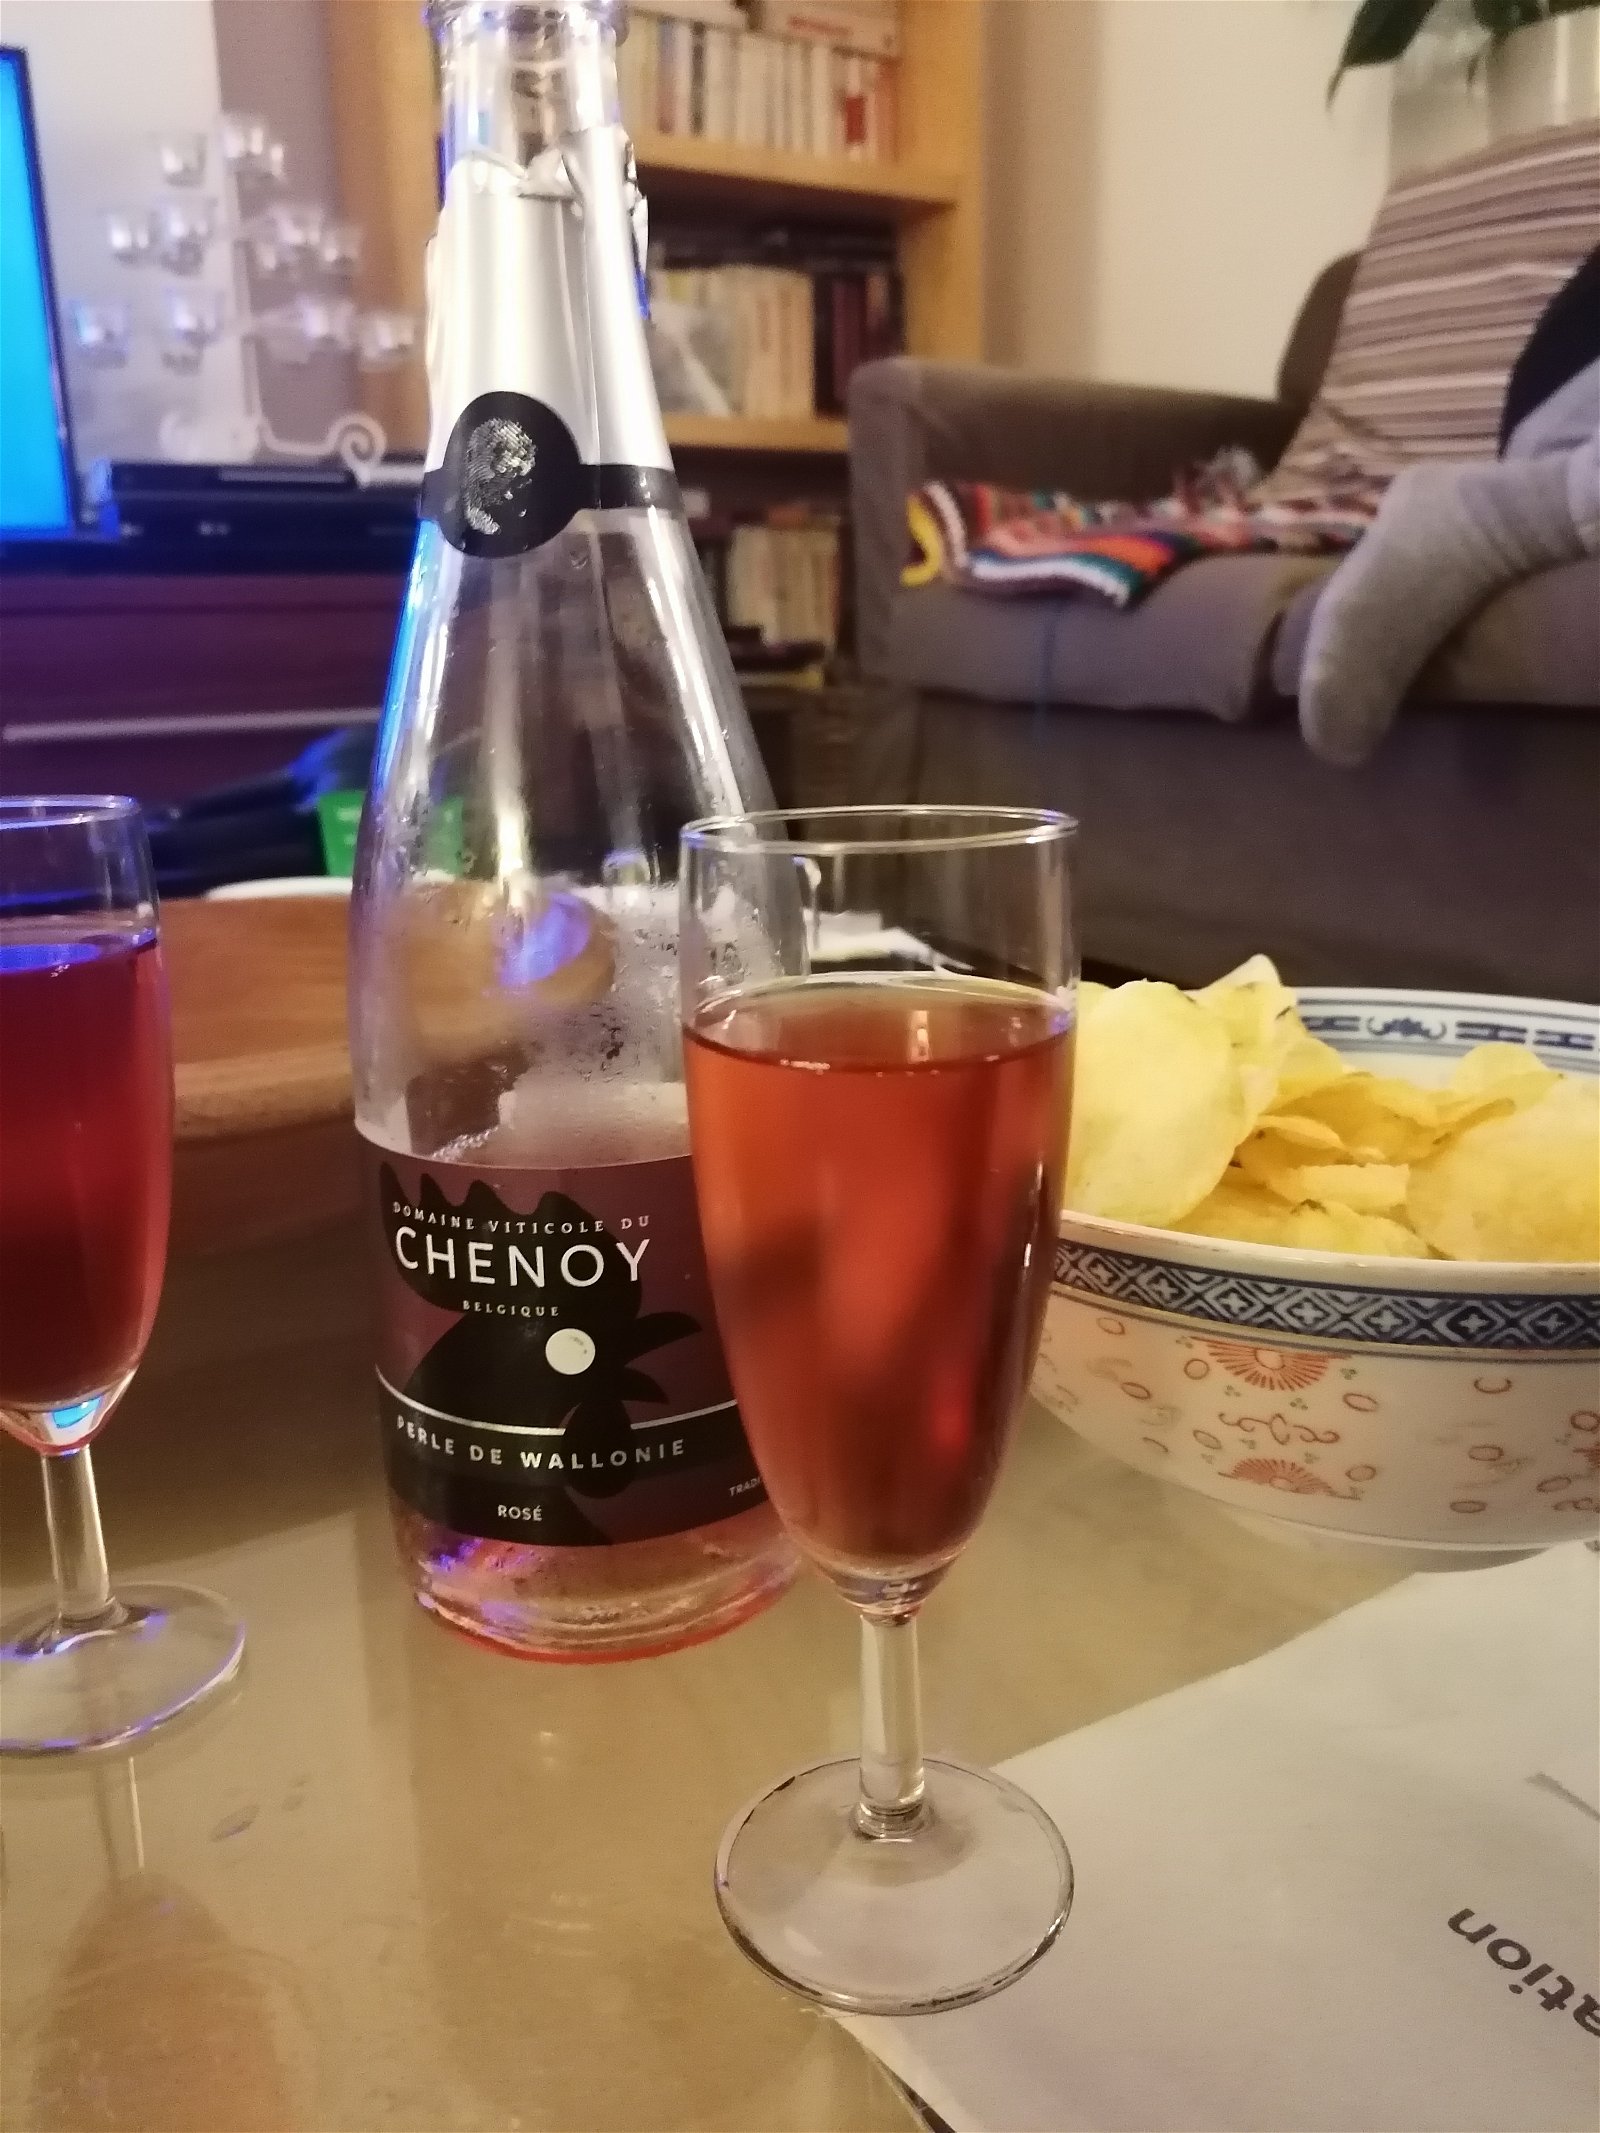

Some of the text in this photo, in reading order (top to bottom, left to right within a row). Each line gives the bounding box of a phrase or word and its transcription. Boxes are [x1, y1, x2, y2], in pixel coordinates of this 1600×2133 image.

[393, 1201, 650, 1235] DOMAINE VITICOLE DU
[396, 1225, 650, 1288] CHENOY
[463, 1300, 559, 1318] BELGIQUE
[397, 1415, 685, 1470] PERLE DE WALLONIE
[498, 1505, 543, 1522] ROSÉ
